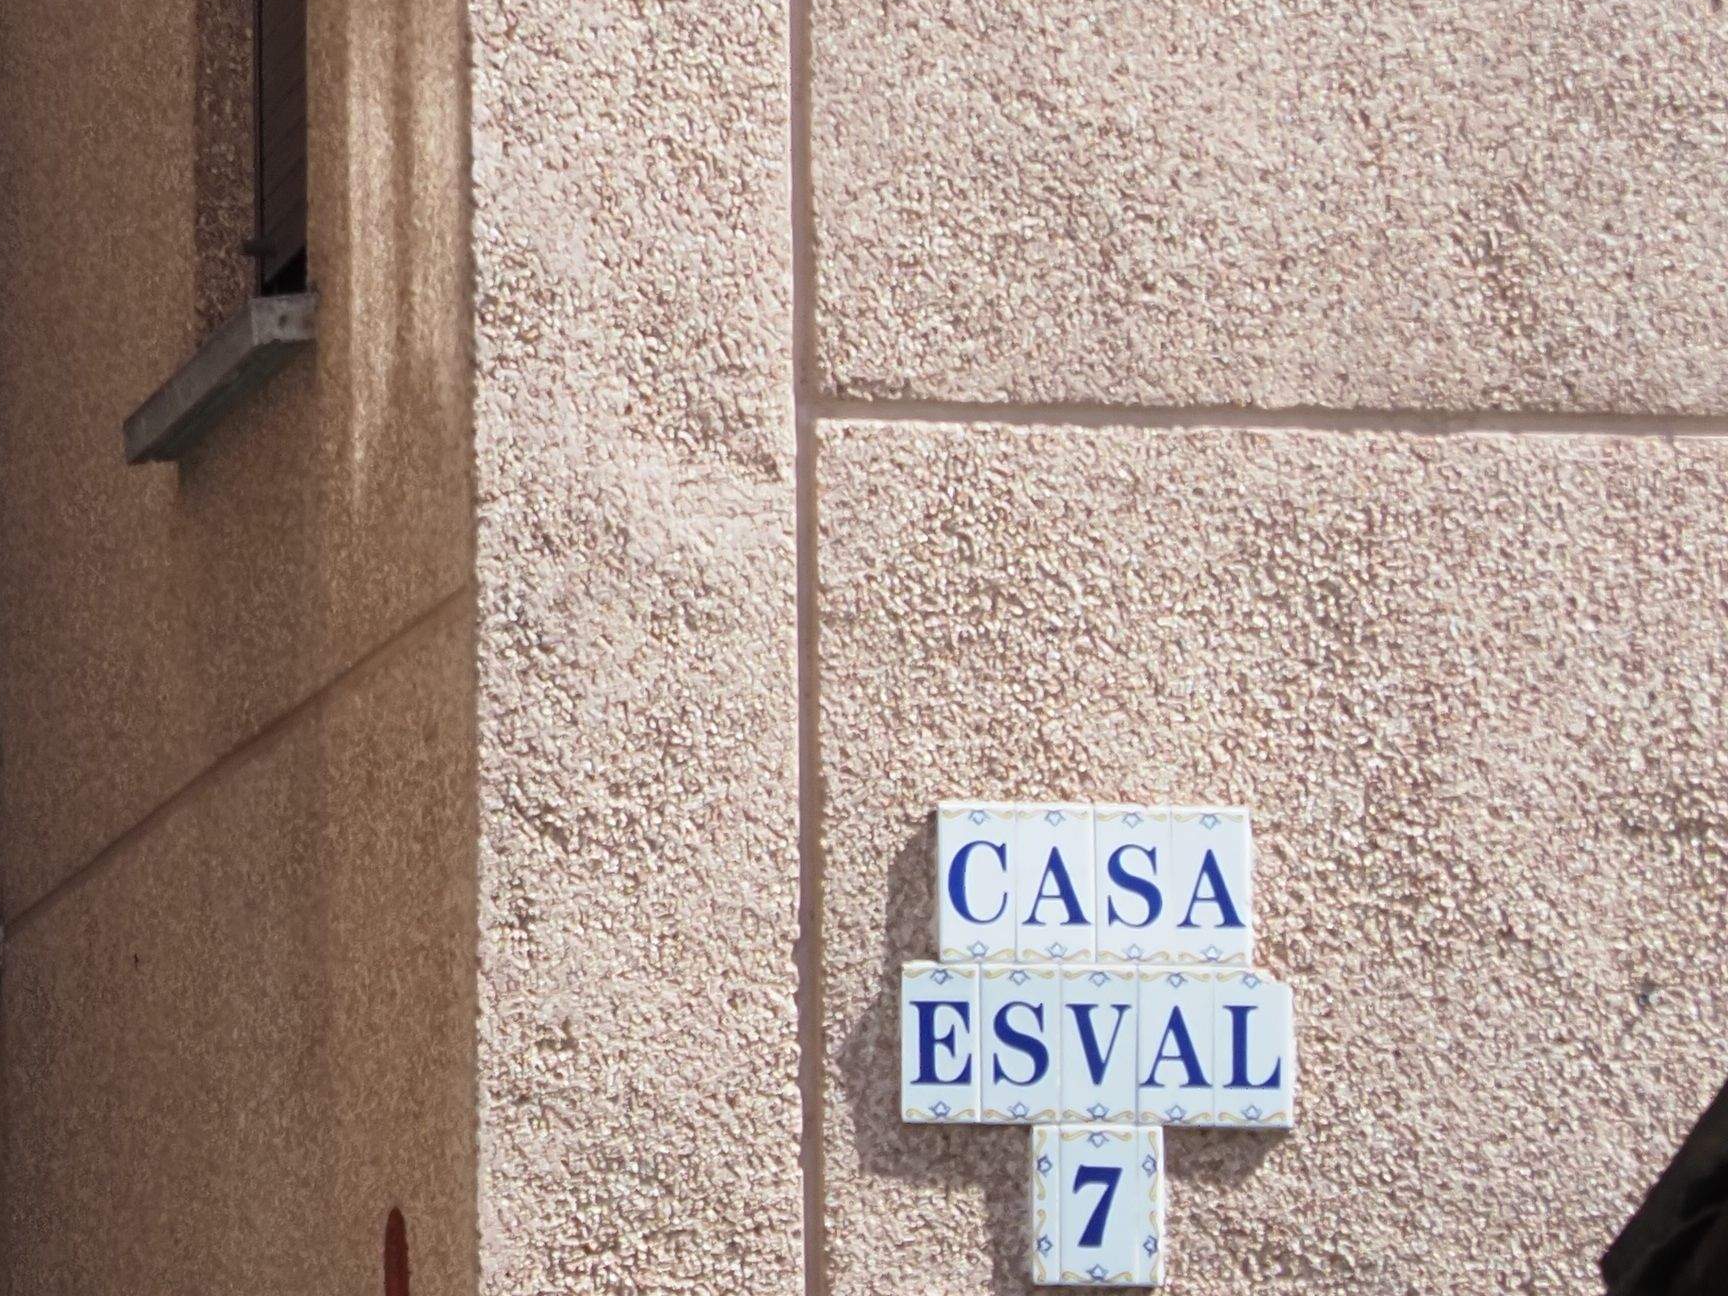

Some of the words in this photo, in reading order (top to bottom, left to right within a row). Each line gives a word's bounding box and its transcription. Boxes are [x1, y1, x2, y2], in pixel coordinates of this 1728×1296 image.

[947, 840, 1246, 929] CASA
[909, 1000, 1282, 1090] ESVAL
[1072, 1164, 1123, 1248] 7
